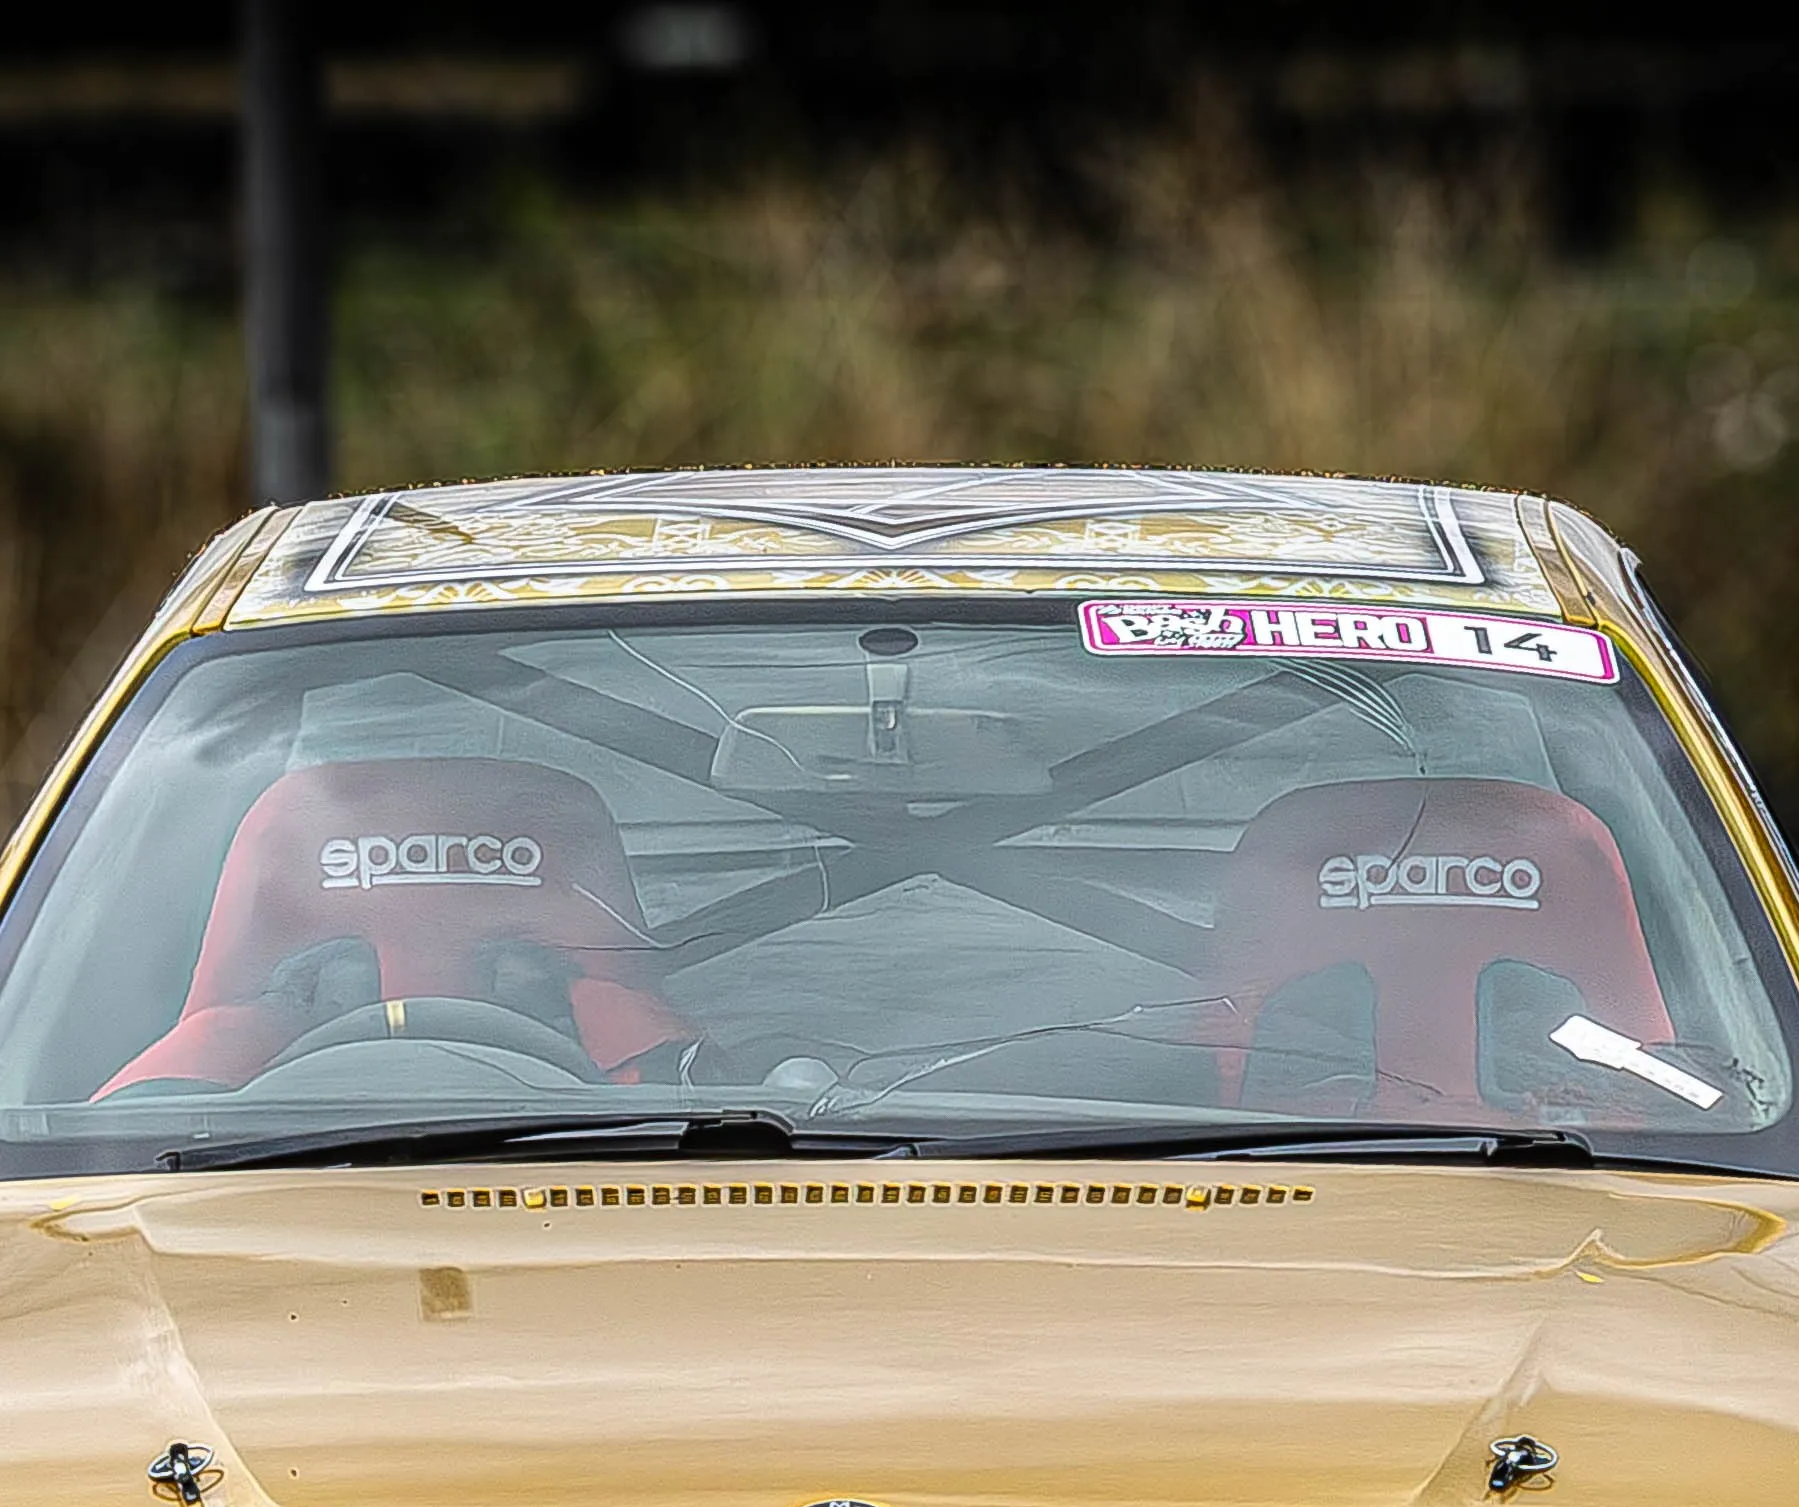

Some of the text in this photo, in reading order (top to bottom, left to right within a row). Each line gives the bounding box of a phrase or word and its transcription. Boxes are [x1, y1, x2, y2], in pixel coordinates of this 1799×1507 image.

[1250, 609, 1428, 652] HERO
[1463, 625, 1558, 662] 14
[319, 835, 543, 890] sparco
[1318, 855, 1542, 909] sparco
